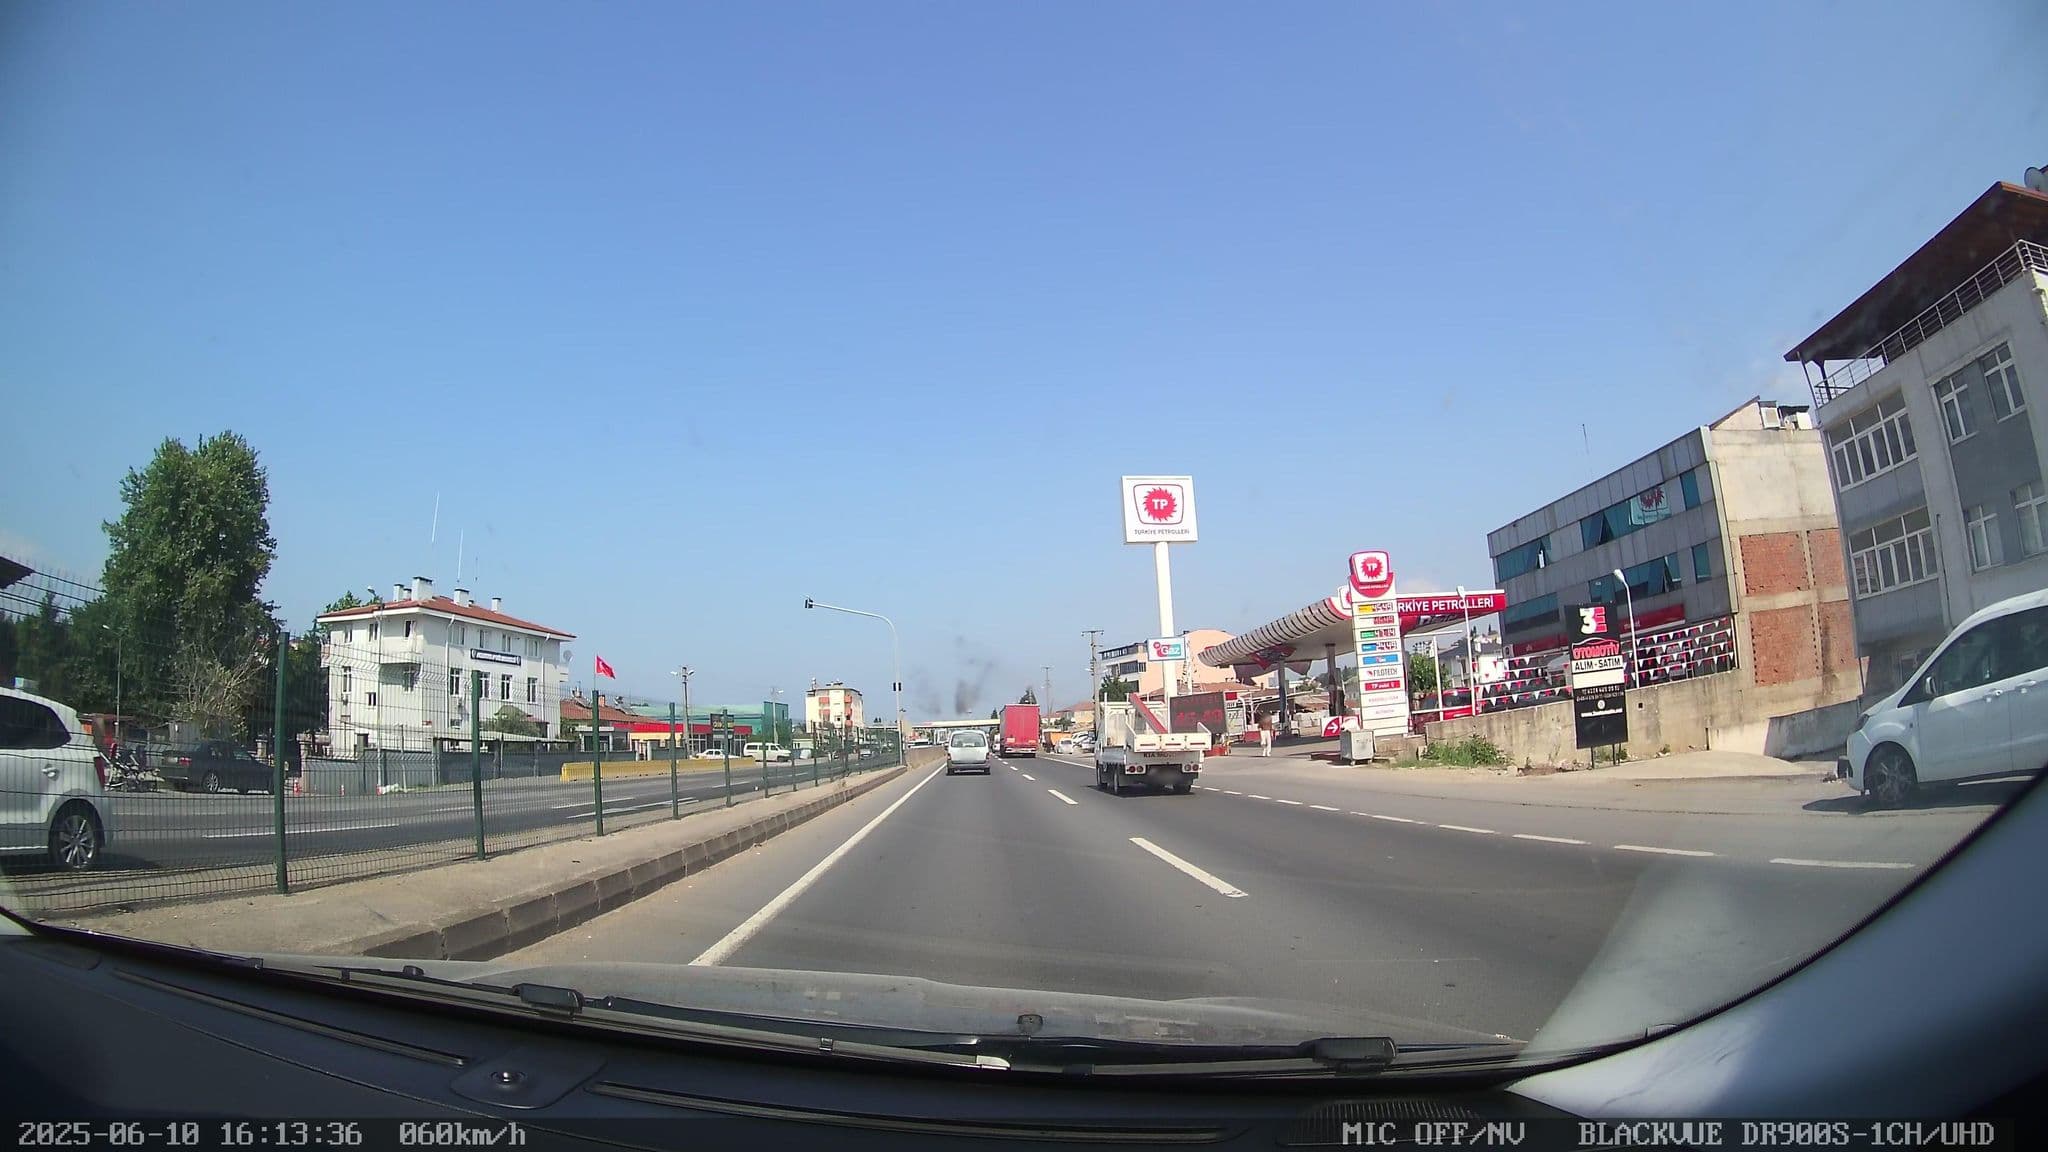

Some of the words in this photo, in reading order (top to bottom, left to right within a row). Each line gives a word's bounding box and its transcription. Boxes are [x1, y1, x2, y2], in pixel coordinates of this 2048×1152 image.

[1152, 499, 1169, 510] TP
[1367, 563, 1378, 571] TP
[1398, 599, 1429, 613] RKİYE
[1432, 596, 1494, 611] PETROLLERİ
[1580, 606, 1608, 635] 3E
